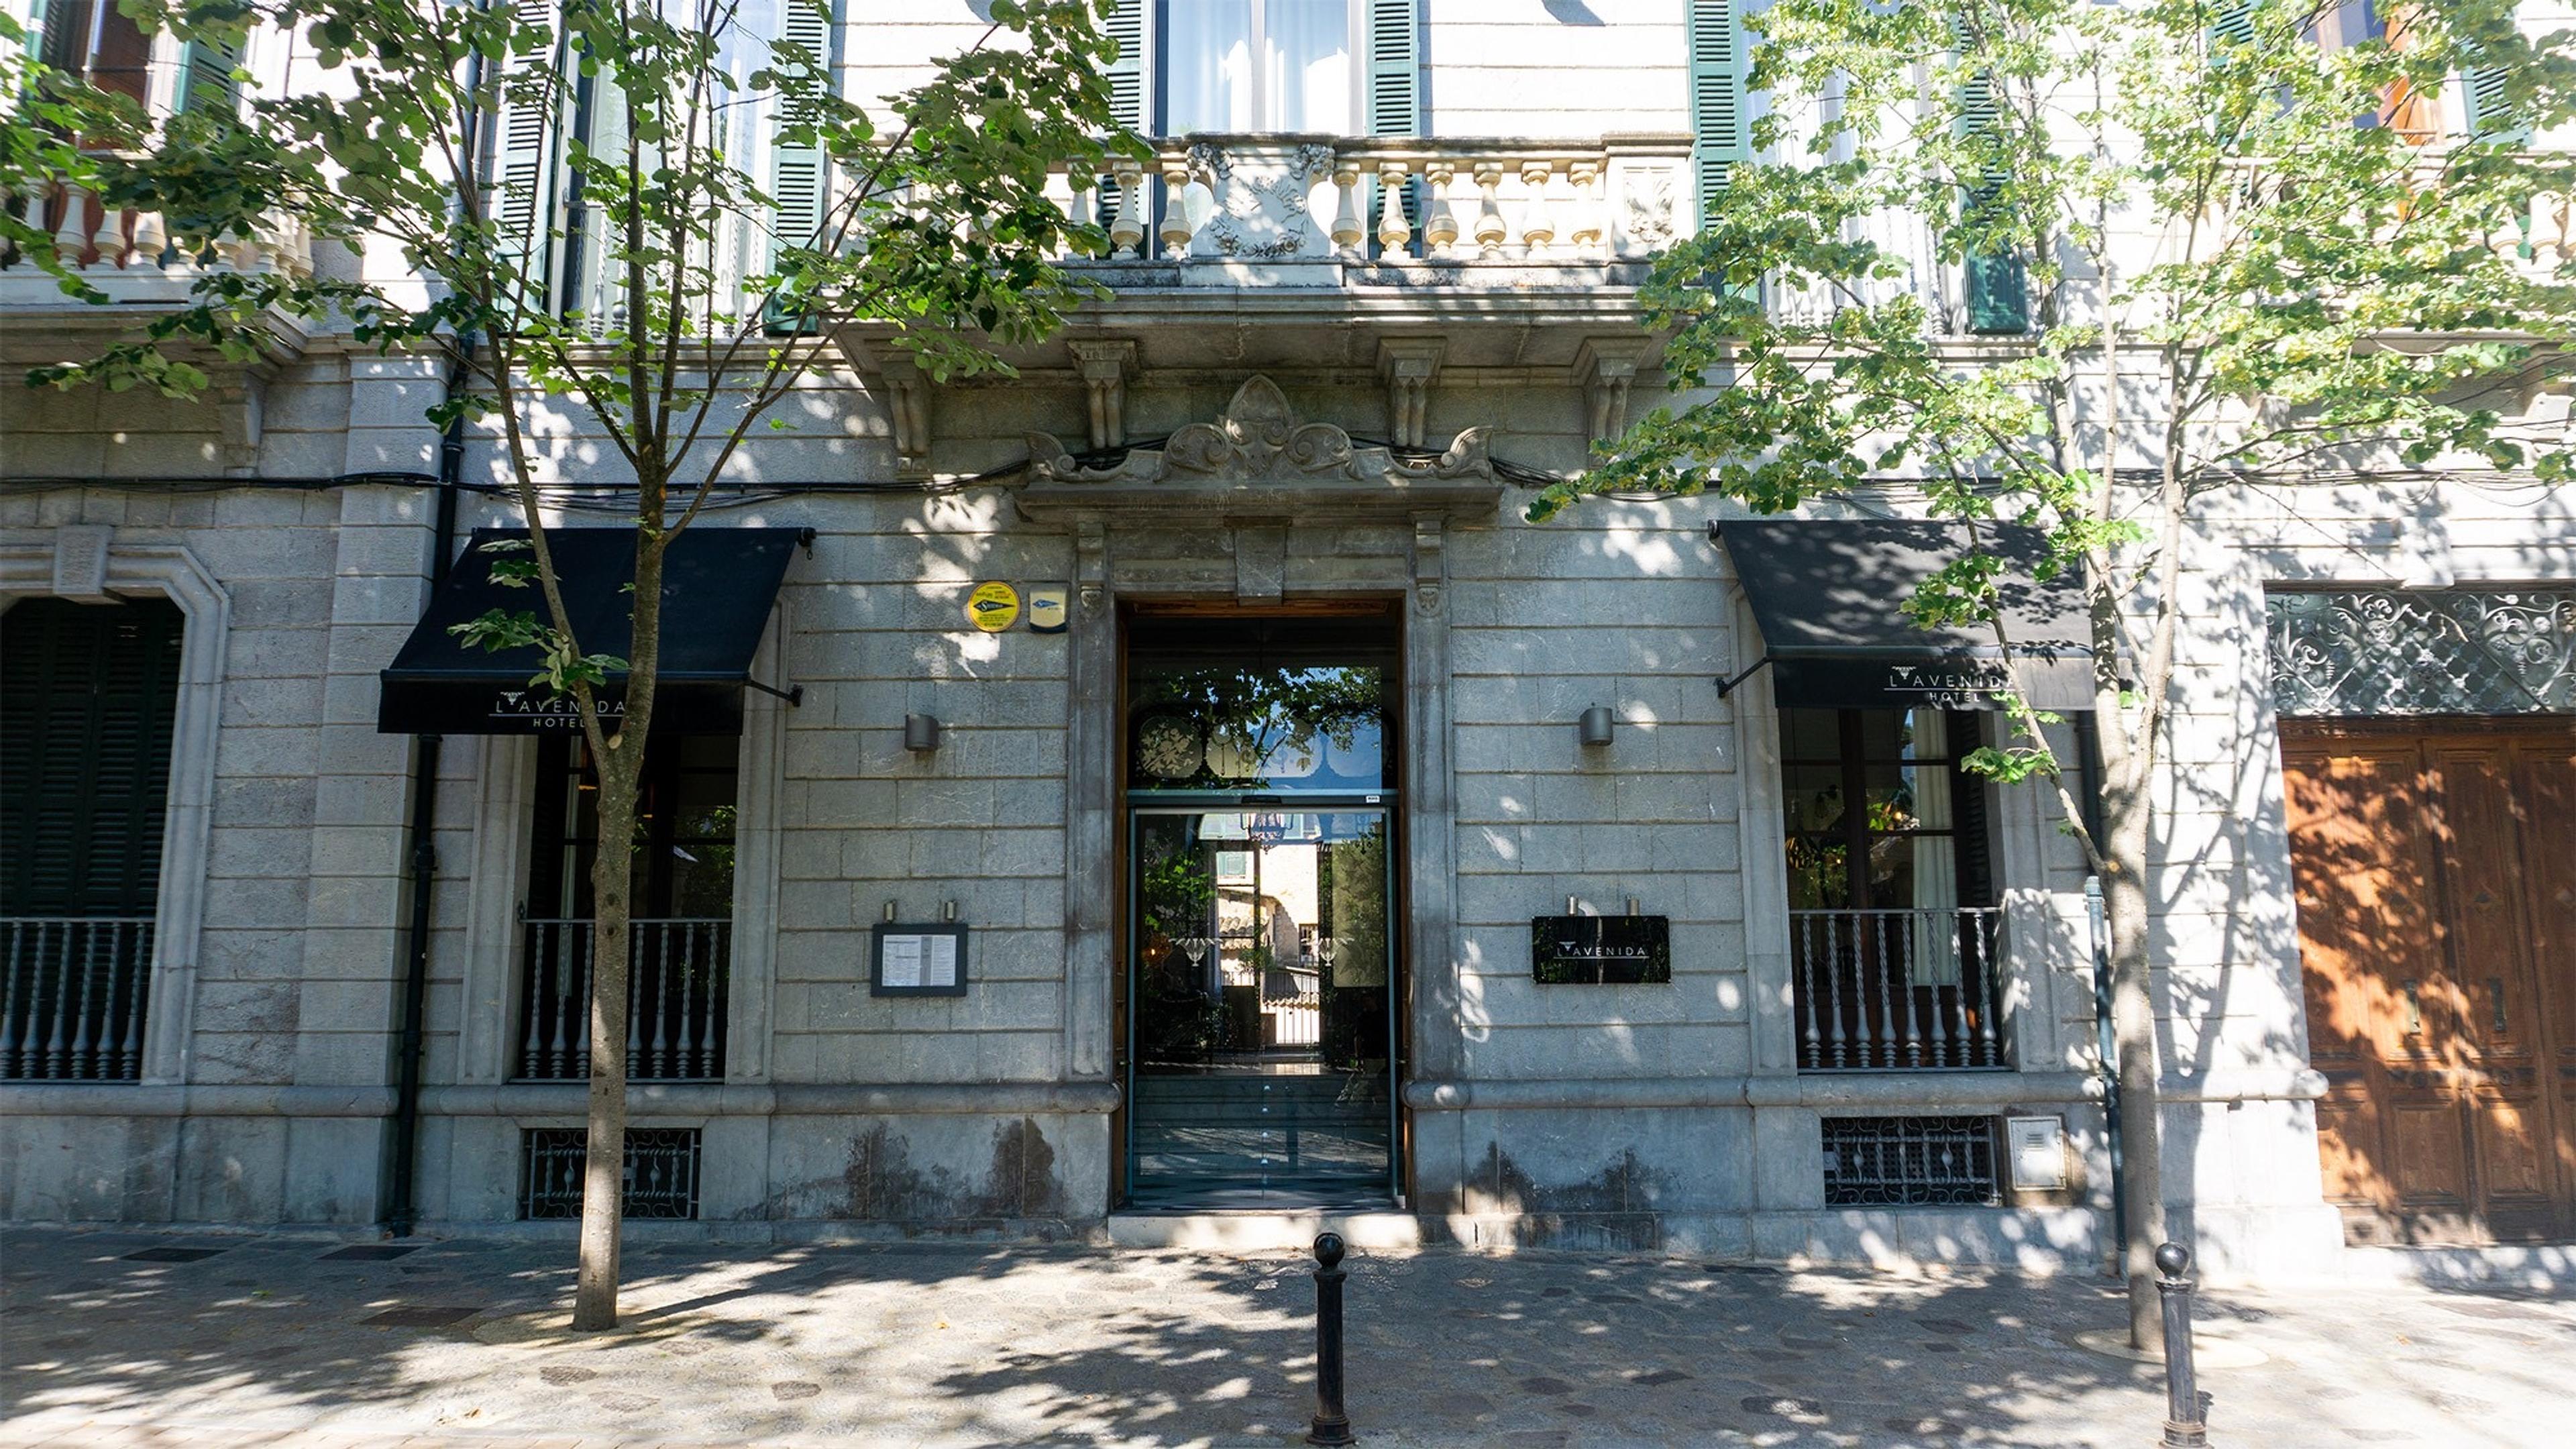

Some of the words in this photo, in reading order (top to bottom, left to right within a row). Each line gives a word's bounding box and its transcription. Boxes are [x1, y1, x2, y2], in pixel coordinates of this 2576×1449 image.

[1929, 692, 1980, 702] HOTEL
[496, 699, 625, 713] L'AVENDA
[533, 717, 585, 728] HOTEL
